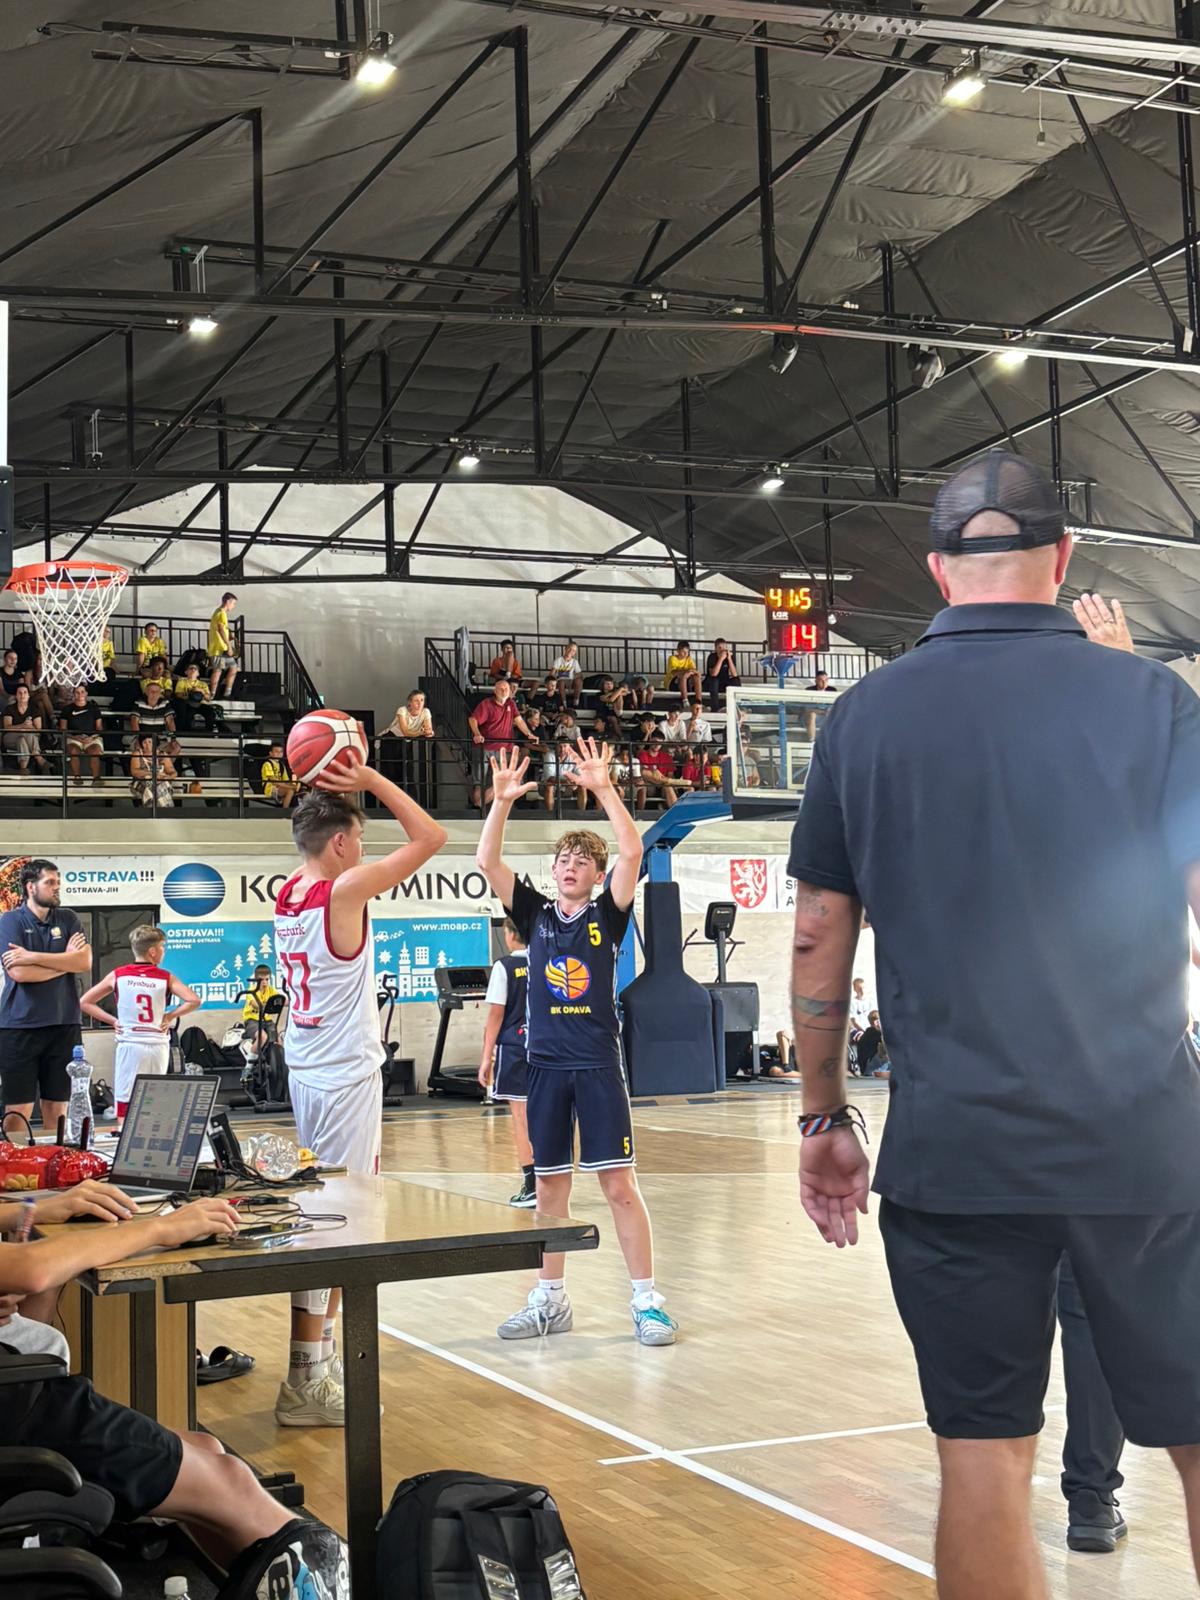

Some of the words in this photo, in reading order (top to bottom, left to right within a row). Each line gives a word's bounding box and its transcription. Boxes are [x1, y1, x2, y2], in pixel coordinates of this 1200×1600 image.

[791, 624, 817, 649] 14
[65, 870, 155, 883] OSTRAVA!!!
[65, 886, 119, 894] OSTRAVA-JIH
[167, 928, 225, 938] OSTRAVA!!!
[412, 921, 483, 932] www.moap.cz
[588, 922, 602, 946] 5
[280, 951, 312, 1012] 17
[136, 993, 154, 1024] 3
[550, 1006, 562, 1015] BK
[562, 1005, 592, 1015] OPAVA
[623, 1136, 630, 1155] 5
